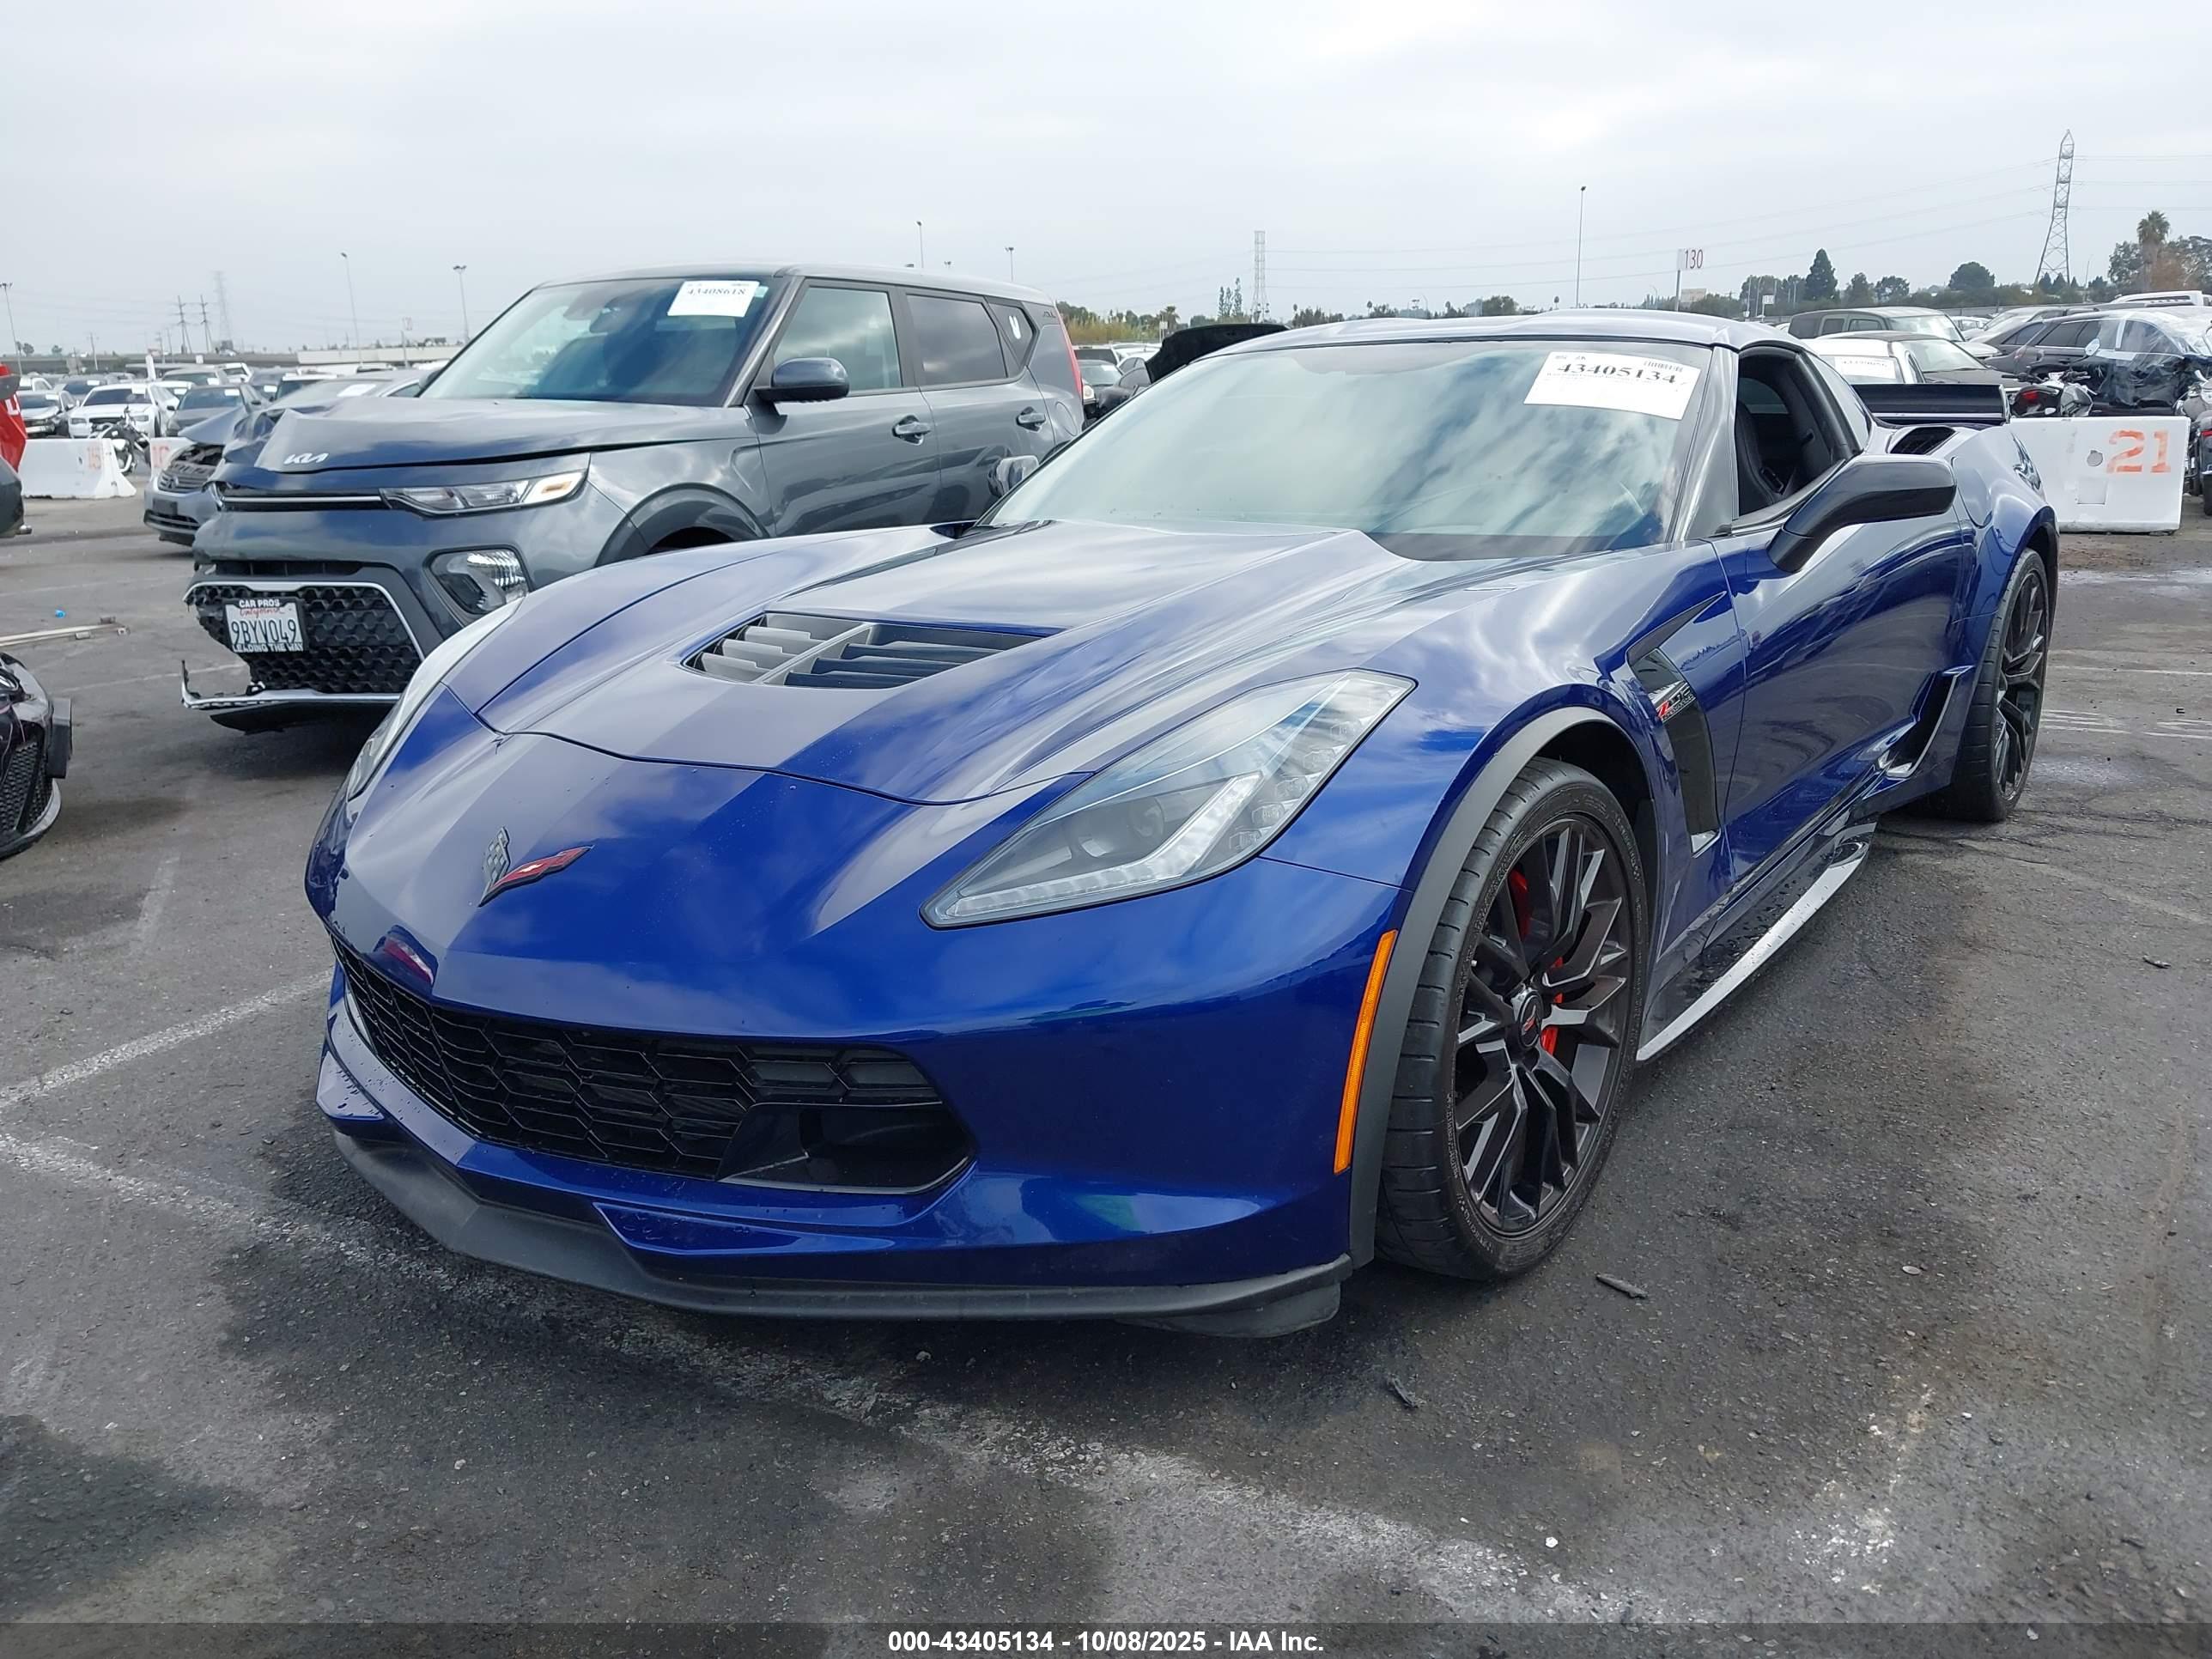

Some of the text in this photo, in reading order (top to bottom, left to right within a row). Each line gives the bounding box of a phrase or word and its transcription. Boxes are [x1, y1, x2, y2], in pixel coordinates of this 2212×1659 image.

[1685, 248, 1704, 270] 130
[1556, 362, 1676, 384] 43405134
[283, 452, 331, 465] KIA
[2106, 429, 2172, 474] 21
[239, 599, 281, 608] CAR PROS
[231, 618, 296, 646] 9BYV049
[233, 641, 304, 653] LEADING THE WAY
